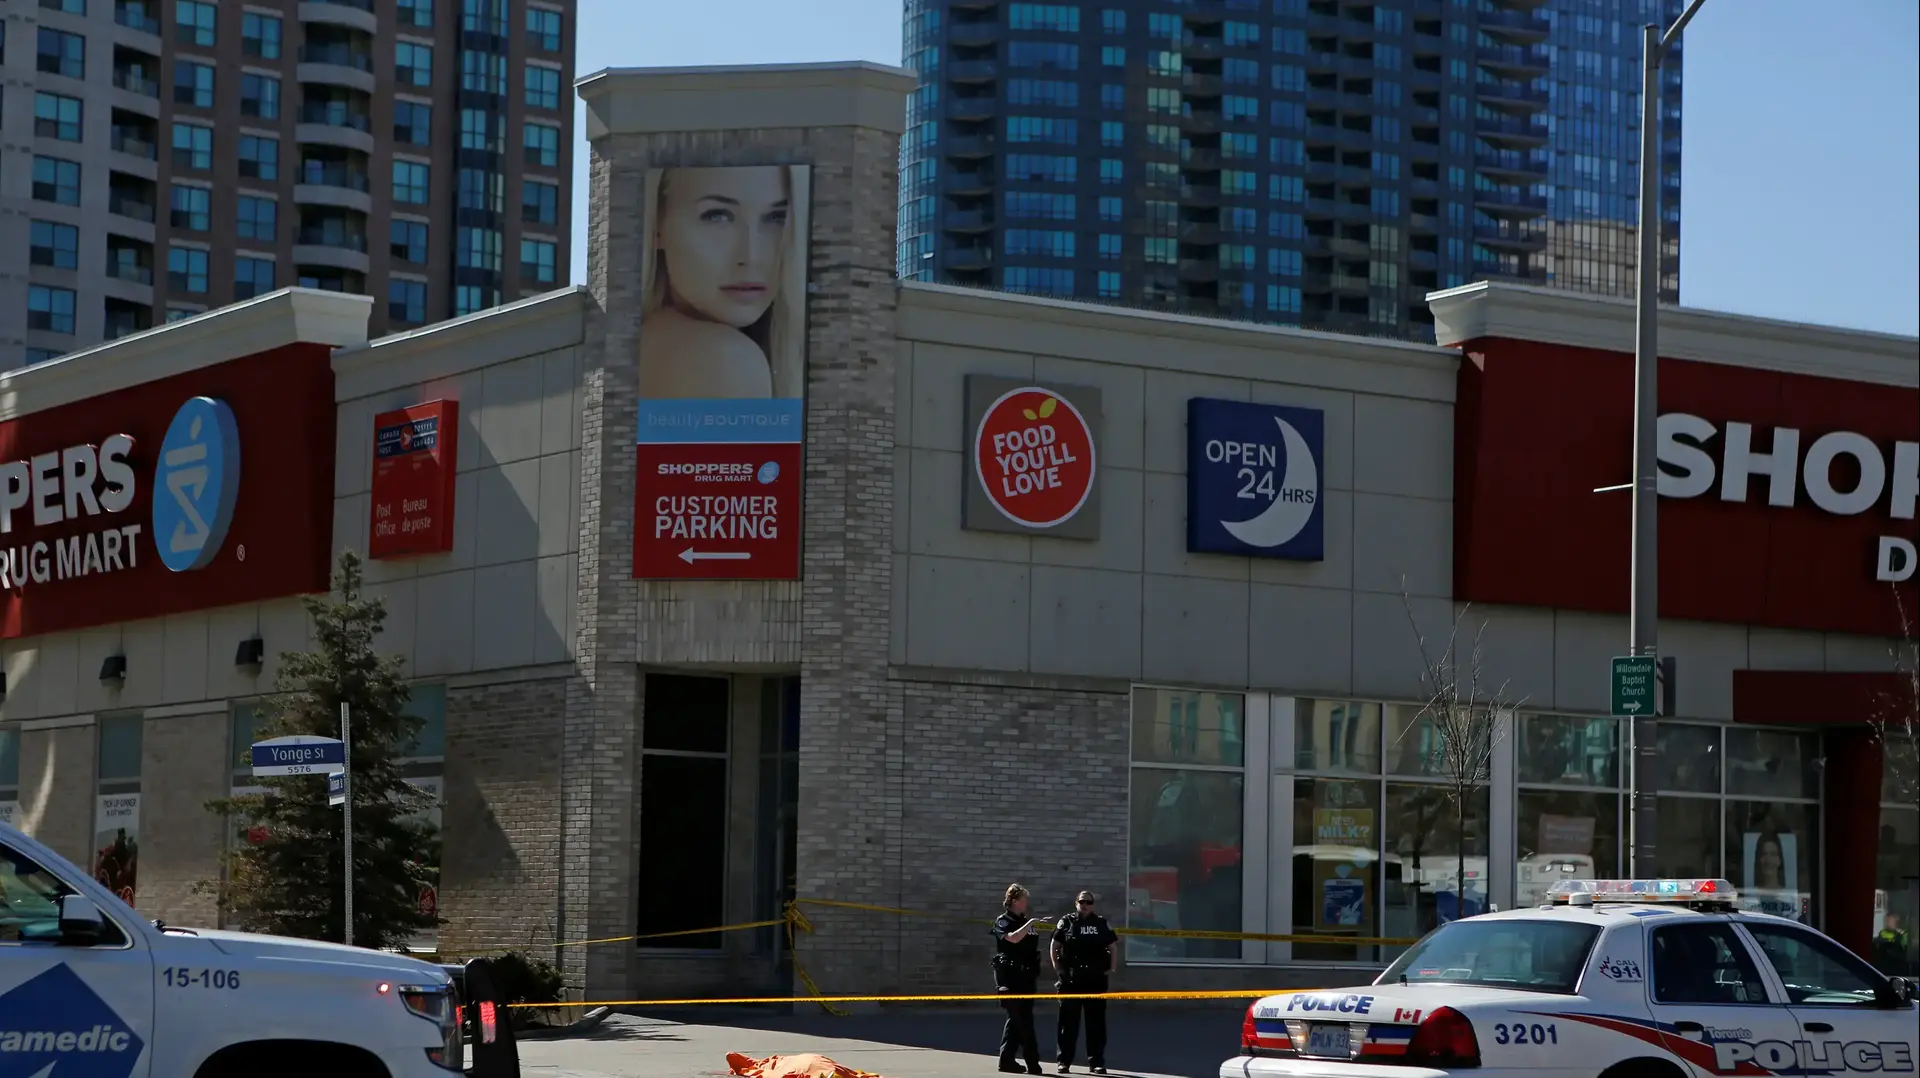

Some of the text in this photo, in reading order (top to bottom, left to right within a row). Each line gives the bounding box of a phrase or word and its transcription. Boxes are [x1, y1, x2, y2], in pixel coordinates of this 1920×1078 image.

[993, 425, 1056, 455] FOOD
[995, 443, 1077, 476] YOU'LL
[1205, 439, 1276, 468] OPEN
[657, 463, 754, 475] SHOPPERS
[1002, 467, 1063, 498] LOVE
[1236, 467, 1315, 504] 24 HRS
[376, 503, 391, 518] Post
[402, 498, 428, 514] Bureau
[655, 496, 777, 515] CUSTOMER
[376, 520, 396, 537] Office
[402, 516, 432, 535] de poste
[655, 516, 777, 539] PARKING
[56, 524, 141, 580] MART
[1615, 664, 1652, 673] Willowdale
[1621, 676, 1646, 686] Baptist
[1621, 687, 1646, 696] Church
[271, 748, 325, 763] Yonge St
[287, 765, 312, 774] 5576
[1317, 825, 1370, 839] MILK?
[1080, 926, 1099, 935] LICE
[162, 966, 241, 989] 15-106
[1287, 994, 1375, 1015] POLICE
[1494, 1023, 1558, 1045] 3201
[1705, 1026, 1753, 1040] Toronto
[1713, 1040, 1915, 1072] POLICE
